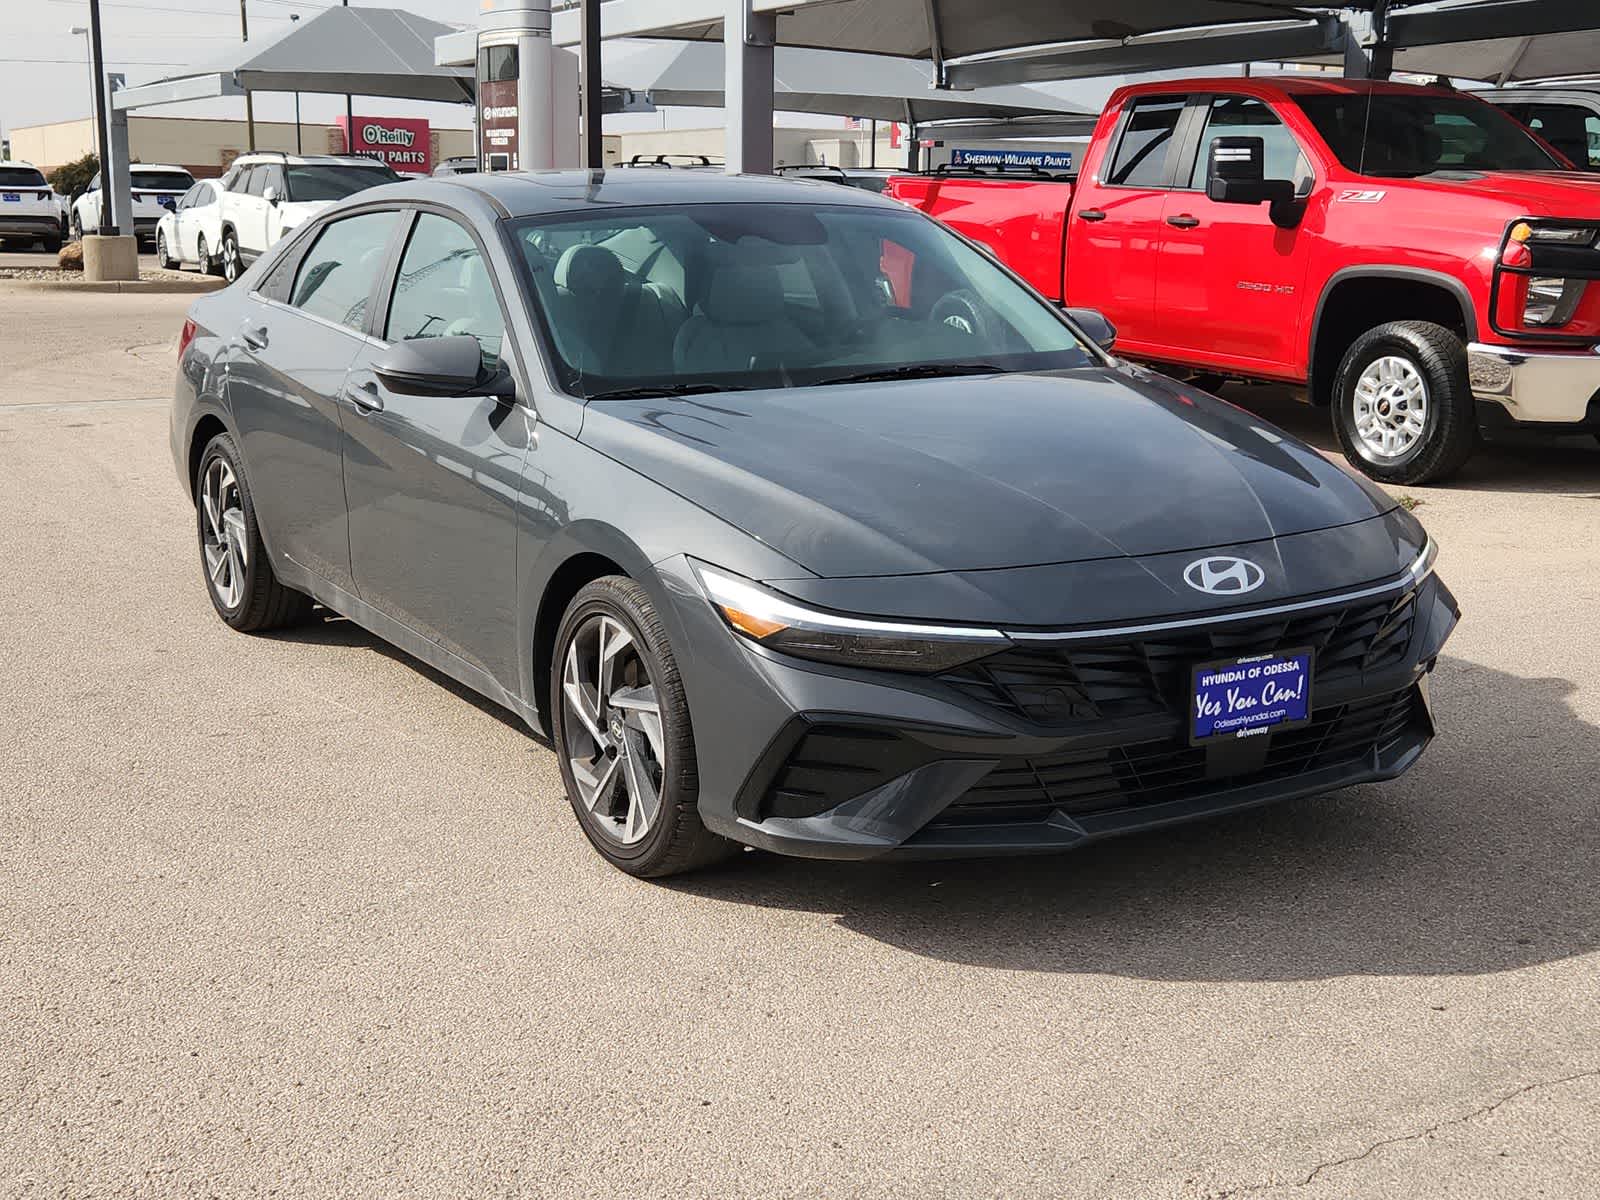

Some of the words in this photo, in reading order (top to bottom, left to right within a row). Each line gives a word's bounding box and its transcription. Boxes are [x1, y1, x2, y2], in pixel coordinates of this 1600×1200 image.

[363, 125, 415, 147] O'Reilly
[388, 151, 425, 163] PARTS
[1044, 155, 1071, 167] PAINTS
[1202, 670, 1246, 687] HYUNDAI
[1247, 667, 1262, 679] OF
[1263, 660, 1300, 676] ODESSA
[1195, 692, 1222, 718] Yes
[1226, 686, 1258, 713] You
[1261, 674, 1305, 706] Can!
[1213, 709, 1286, 729] OdessaHyundai.com
[1236, 725, 1269, 738] driveway
